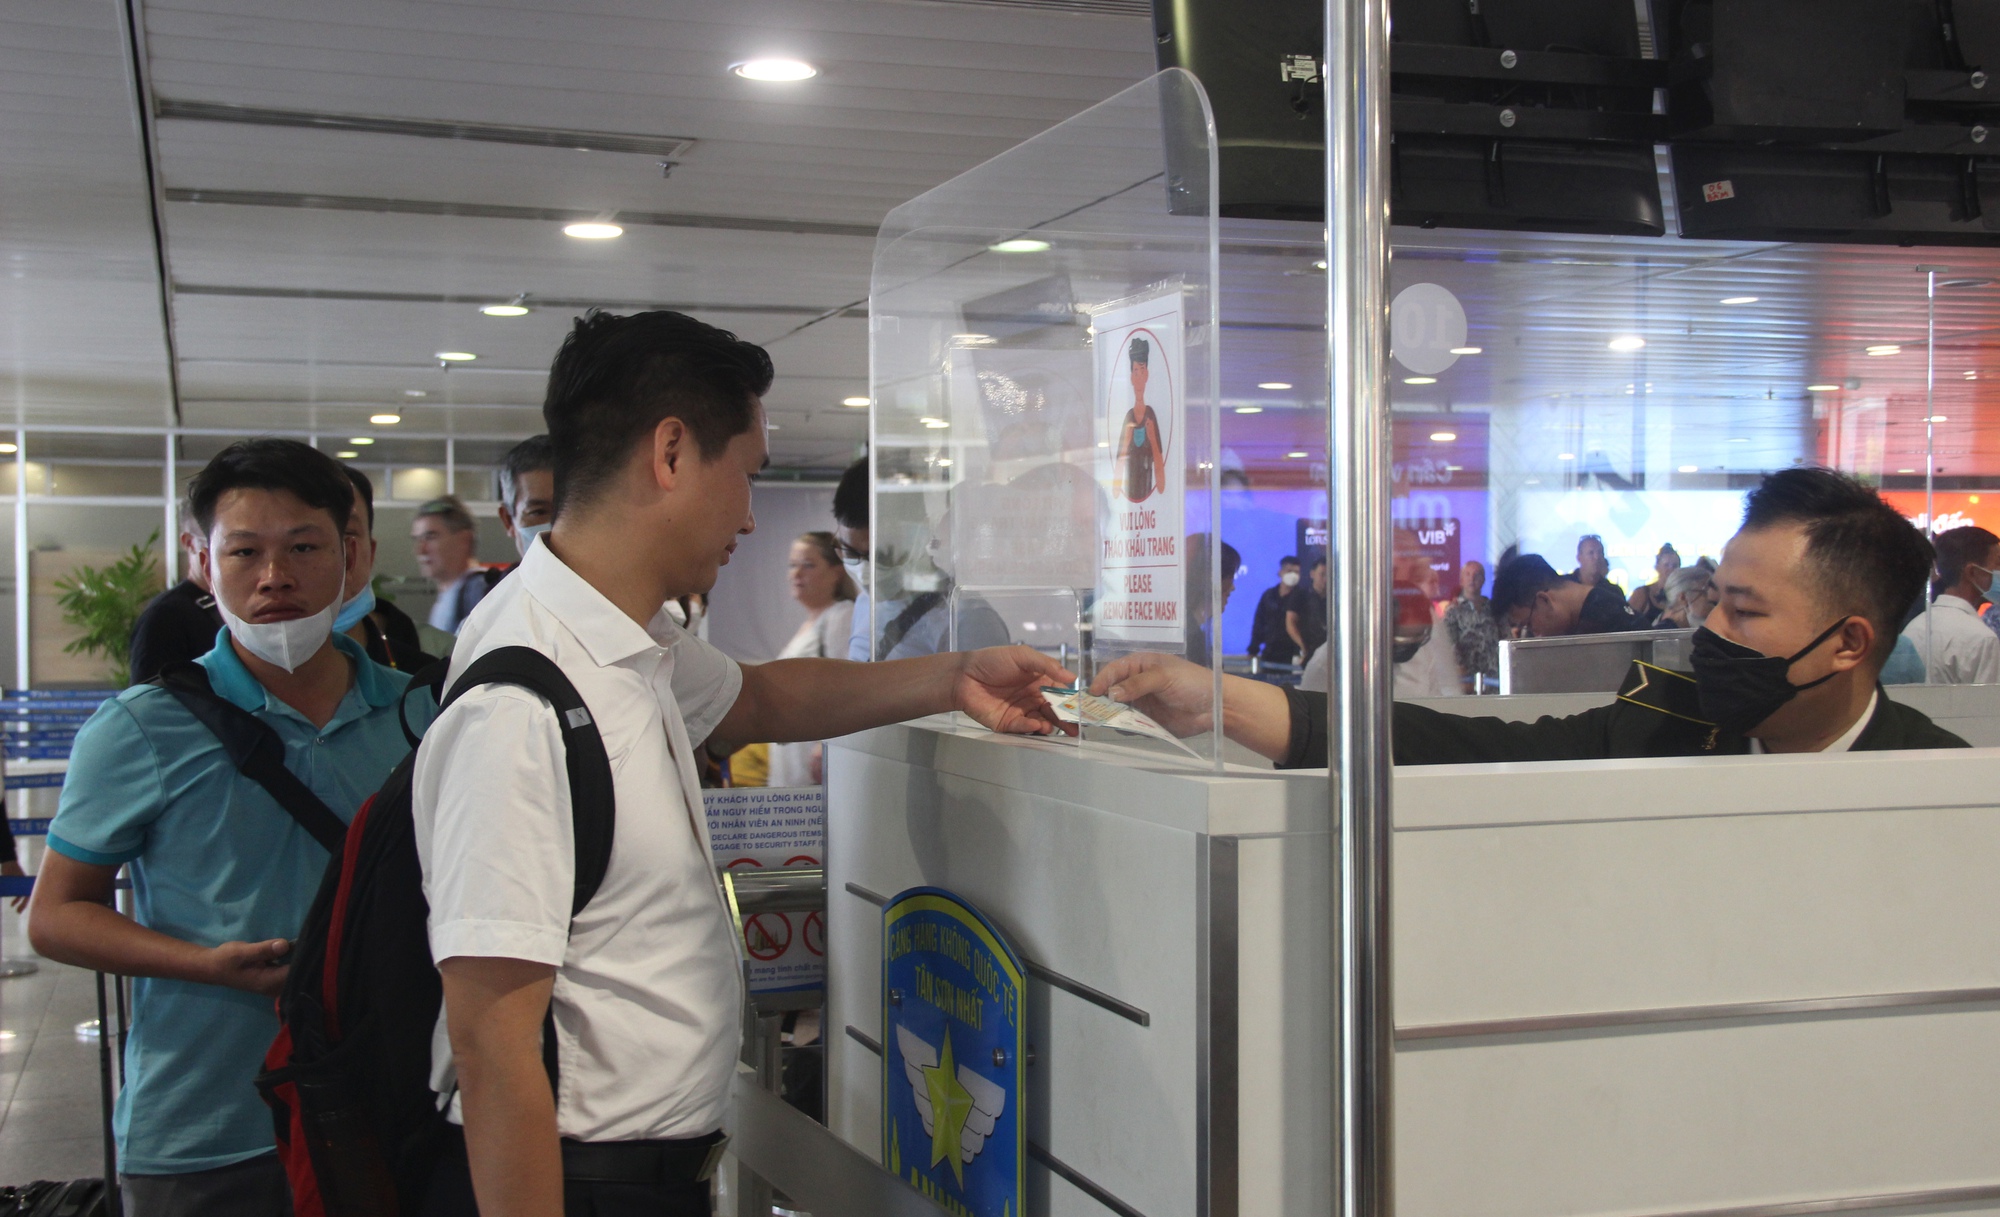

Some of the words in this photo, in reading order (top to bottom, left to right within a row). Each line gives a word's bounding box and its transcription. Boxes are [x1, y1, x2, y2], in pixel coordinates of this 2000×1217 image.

[1120, 511, 1133, 531] VUI
[1135, 506, 1156, 530] LÒNG
[1147, 536, 1174, 556] TRANG
[1418, 530, 1446, 545] VIB
[1124, 574, 1152, 593] PLEASE
[1104, 601, 1132, 620] REMOVE
[1134, 601, 1153, 620] FACE
[1155, 601, 1177, 620] MASK
[718, 794, 748, 804] KHÁCH
[751, 795, 764, 803] VUI
[767, 793, 790, 802] LÒNG
[793, 794, 813, 802] KHAI
[722, 808, 747, 816] NGUY
[773, 806, 803, 814] TRONG
[722, 818, 746, 829] NHÂN
[749, 818, 768, 828] VIÊN
[771, 819, 783, 827] AN
[785, 818, 805, 826] NINH
[711, 833, 748, 841] DECLARE
[750, 831, 798, 840] DANGEROUS
[799, 830, 822, 838] ITEMS
[711, 843, 741, 851] GGAGE
[742, 842, 753, 850] TO
[755, 841, 791, 849] SECURITY
[793, 840, 816, 848] STAFF
[890, 922, 911, 961] CẢNG
[940, 926, 971, 971] KHÔNG
[974, 948, 999, 1003] QUỐC
[1003, 982, 1014, 1027] TẾ
[915, 963, 933, 1004] TÂN
[956, 987, 983, 1032] NHẤT
